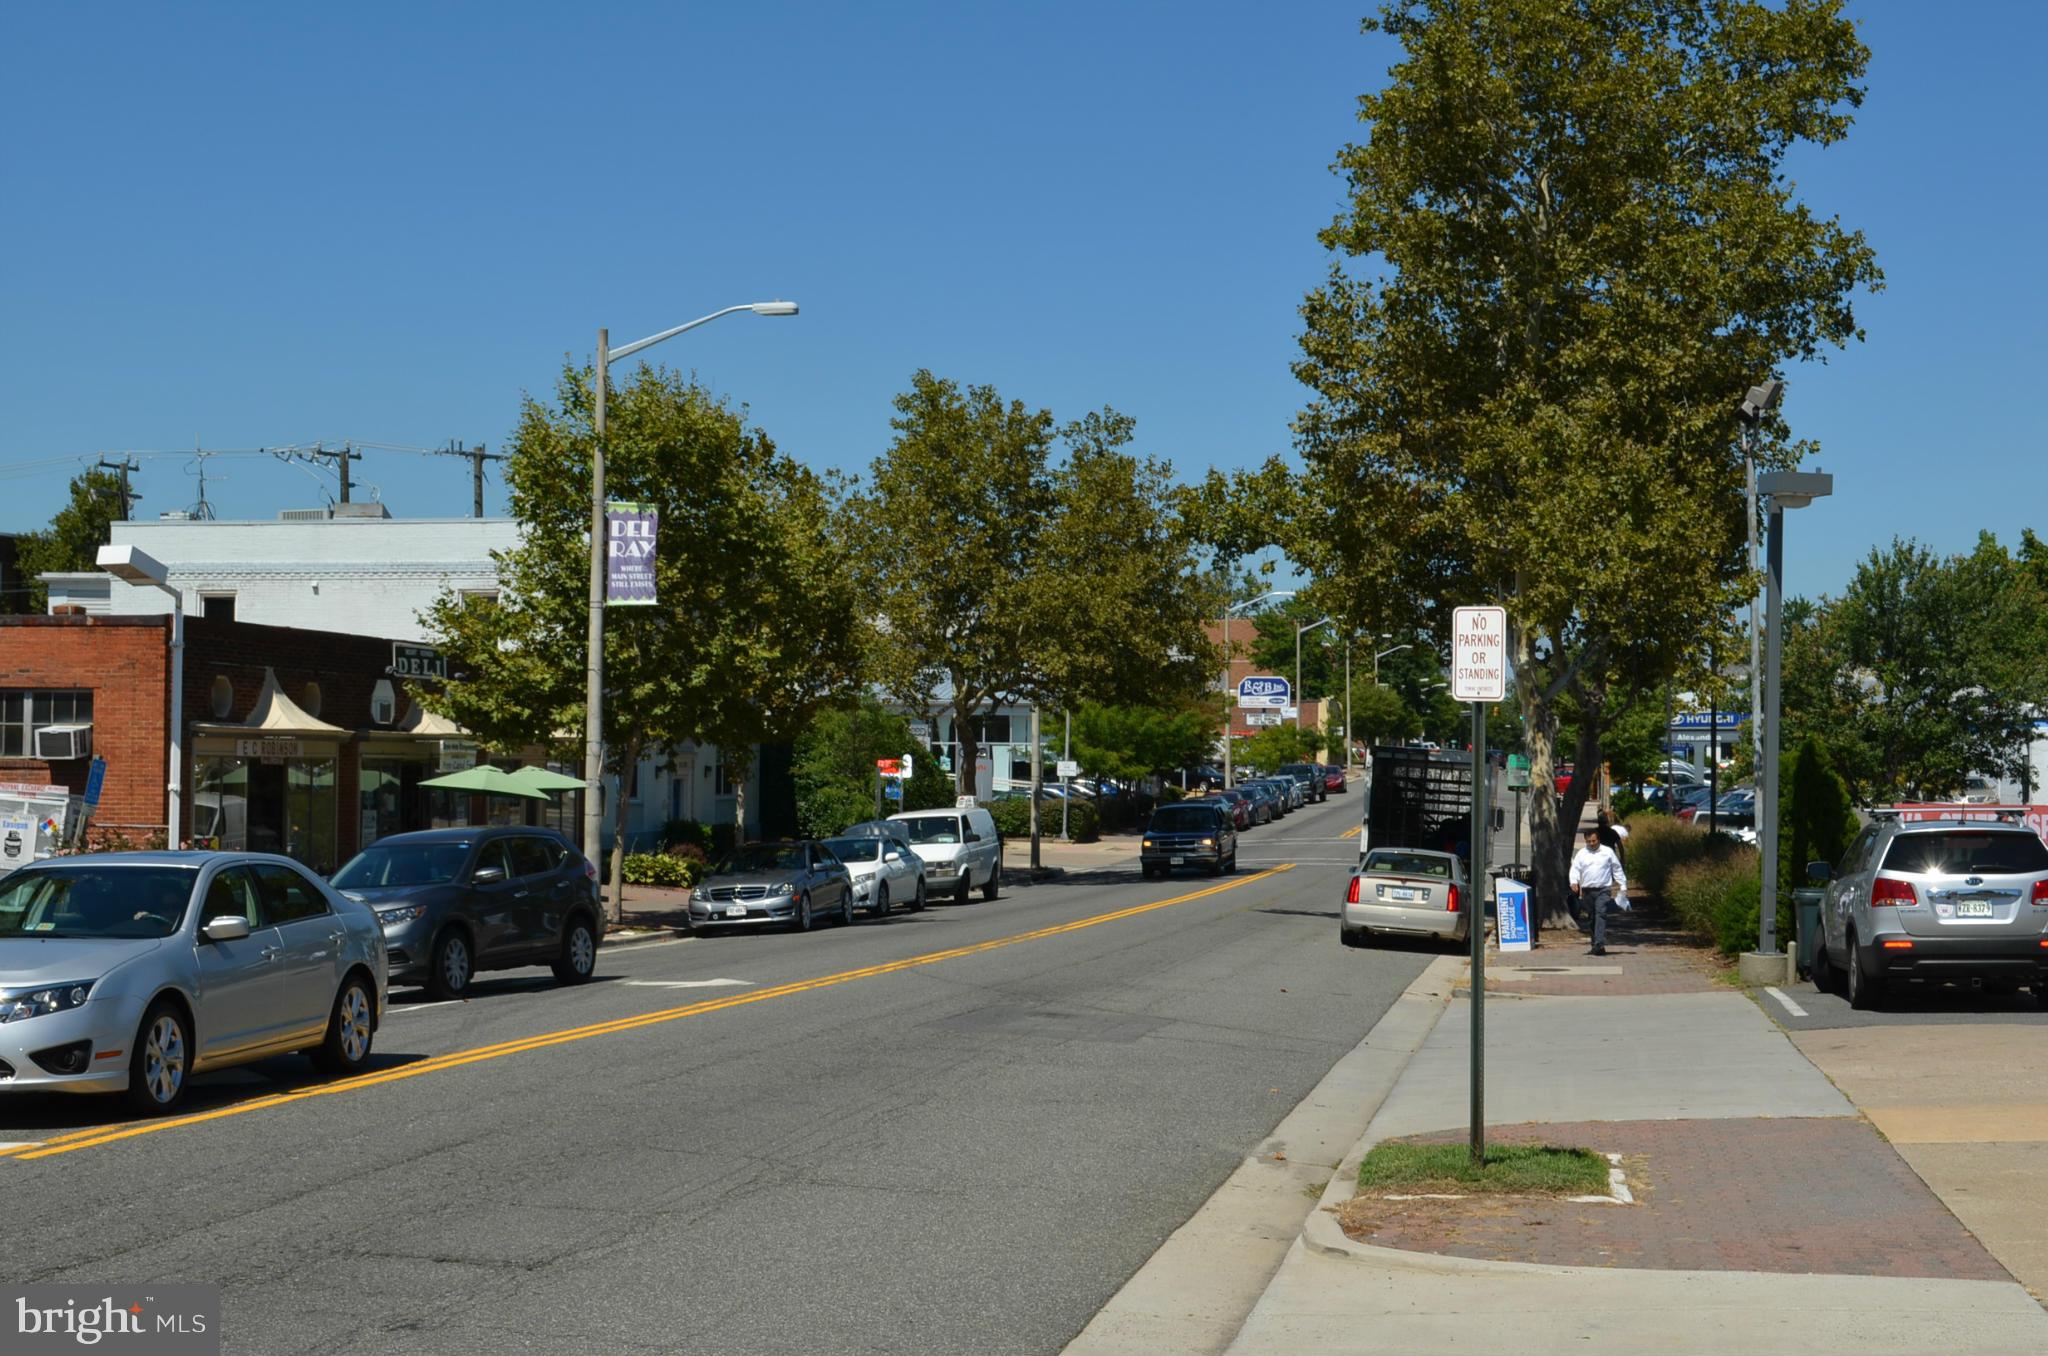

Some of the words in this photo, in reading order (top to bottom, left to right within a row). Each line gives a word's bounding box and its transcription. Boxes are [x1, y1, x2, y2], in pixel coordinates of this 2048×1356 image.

[611, 520, 656, 537] DEL
[609, 540, 655, 558] RAY
[630, 581, 653, 589] EXISTS
[1472, 617, 1487, 630] NO
[1459, 634, 1500, 647] PARKING
[1472, 652, 1486, 664] OR
[398, 657, 442, 676] DELI
[1459, 668, 1500, 680] STANDING
[1687, 715, 1734, 723] HYUDAI
[243, 742, 248, 755] E
[1500, 896, 1510, 939] APARTMENT
